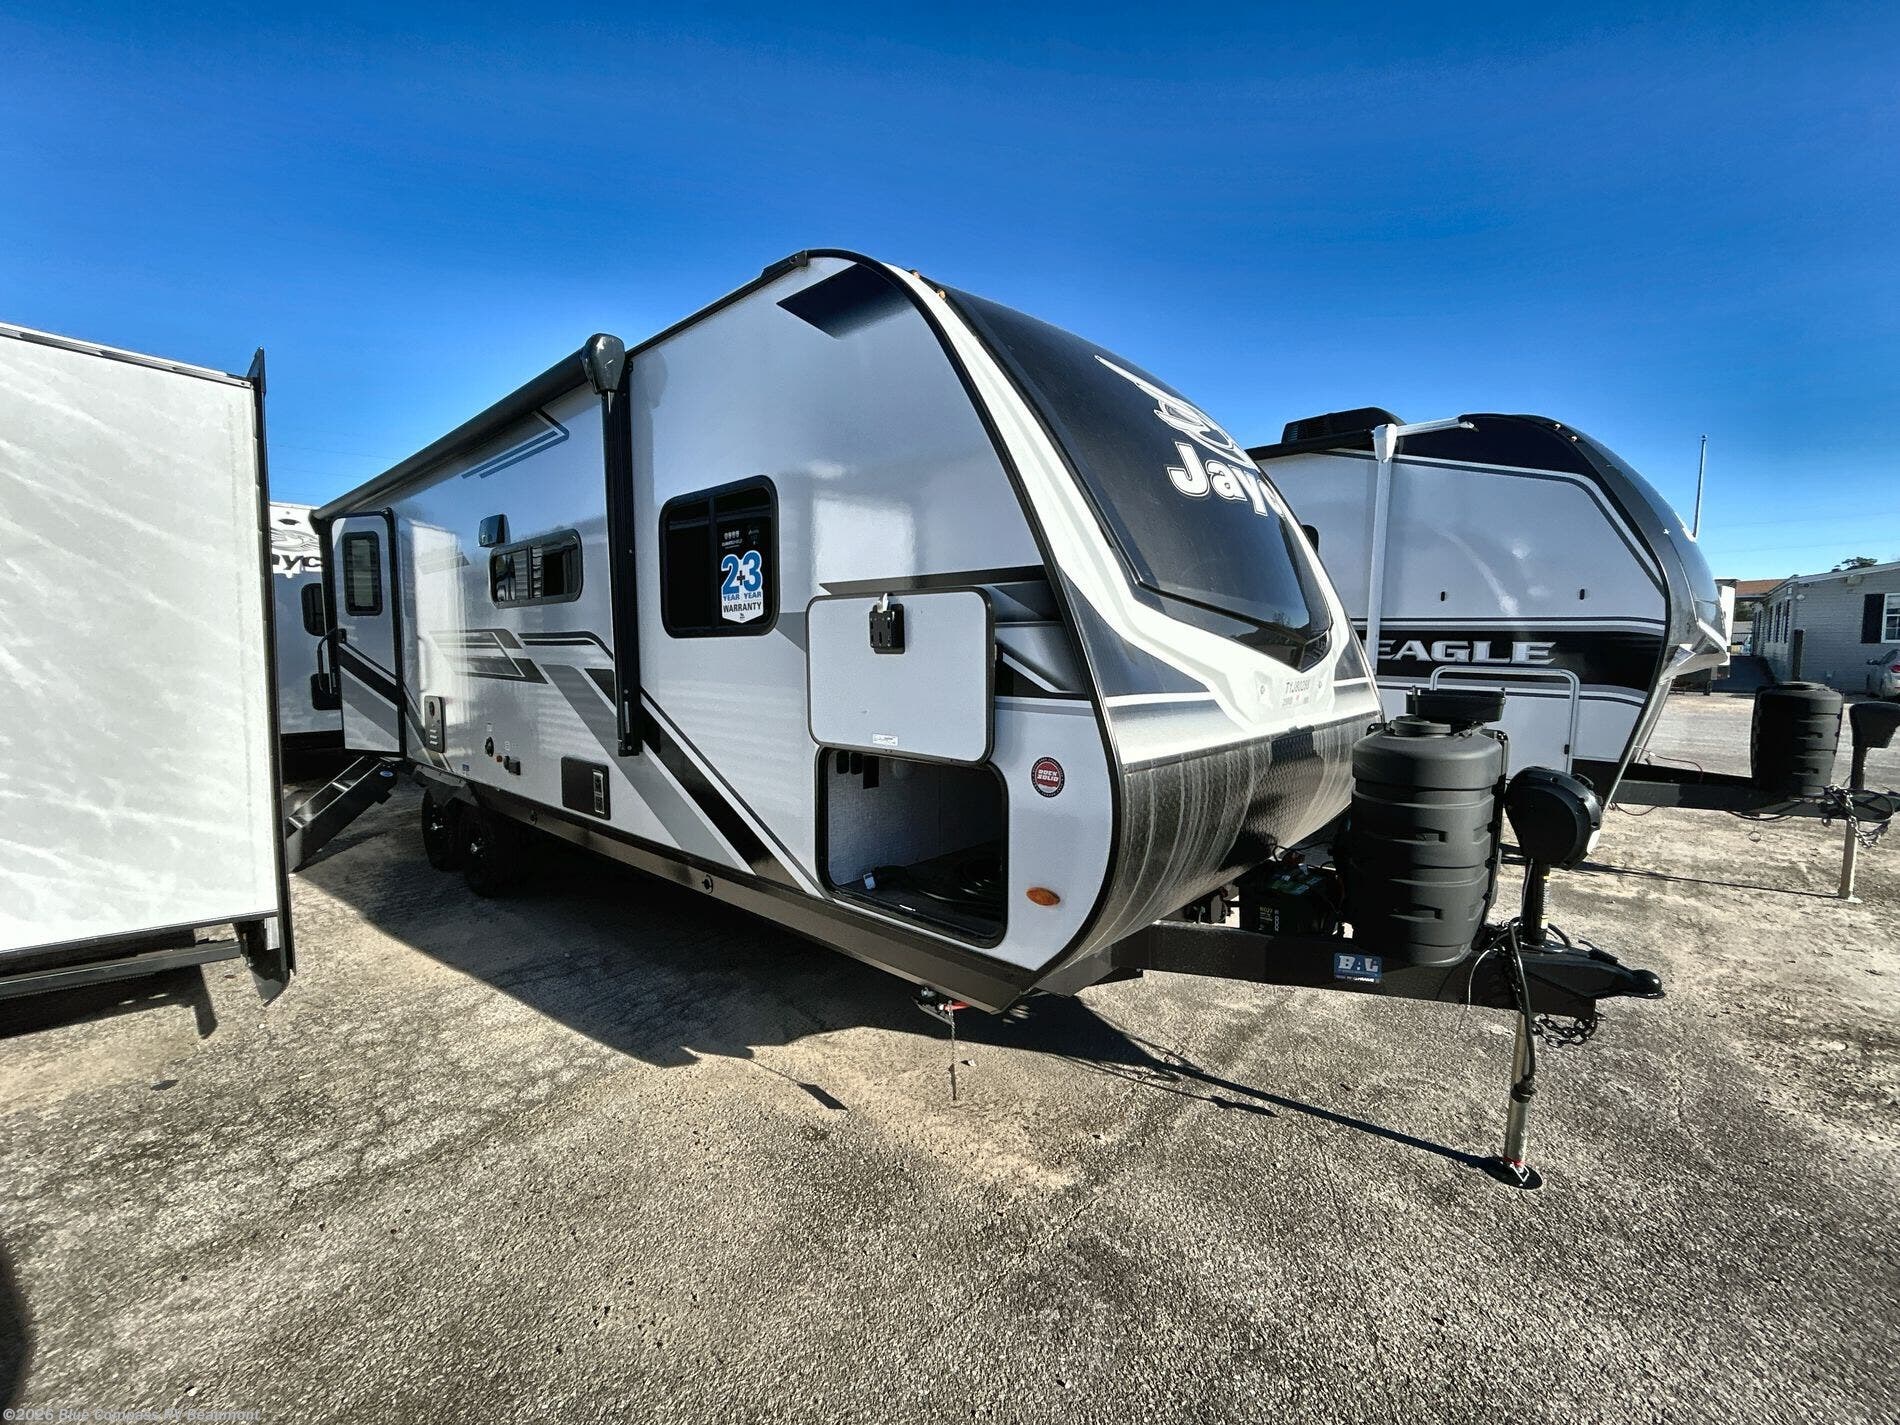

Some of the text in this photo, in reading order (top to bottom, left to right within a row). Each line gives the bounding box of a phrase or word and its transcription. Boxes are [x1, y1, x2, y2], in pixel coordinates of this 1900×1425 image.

[744, 592, 762, 600] YEAR
[723, 602, 762, 613] WARRANTY
[1362, 640, 1557, 665] EAGLE
